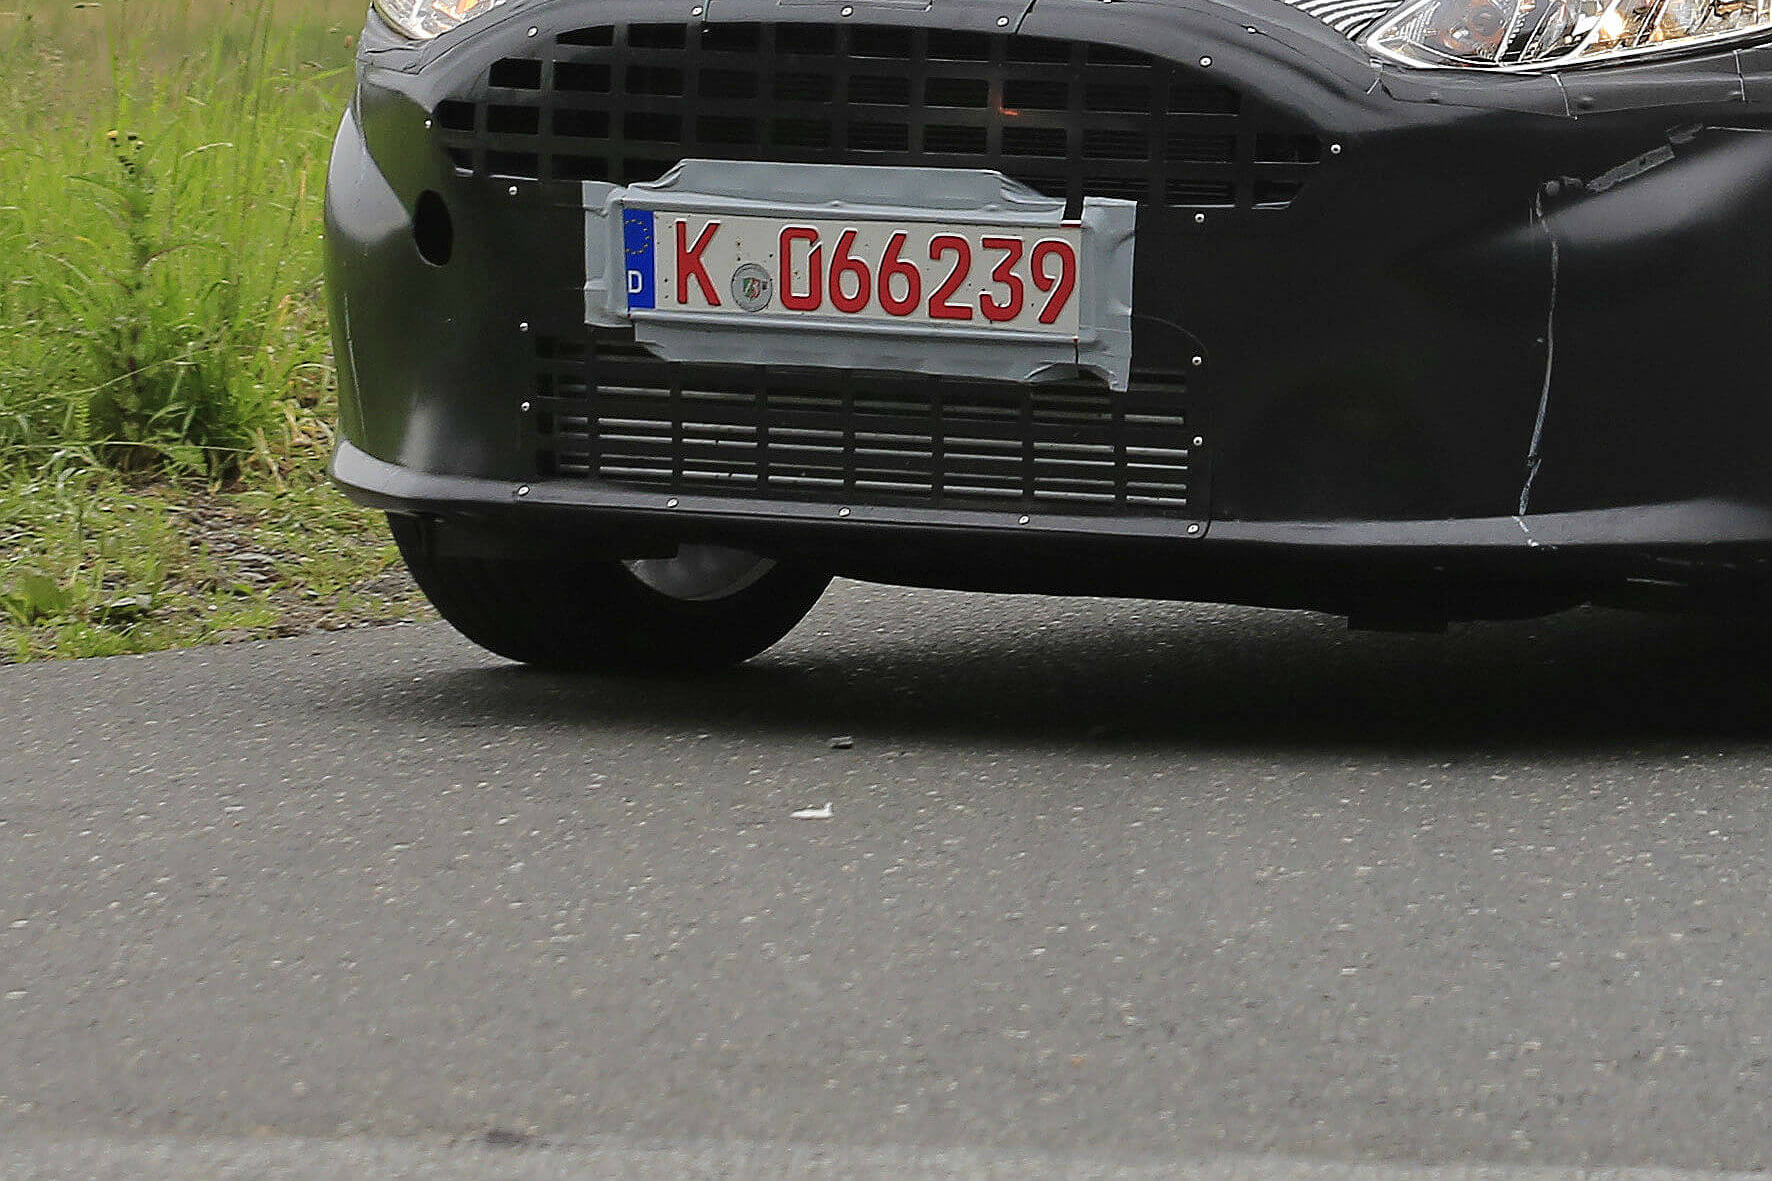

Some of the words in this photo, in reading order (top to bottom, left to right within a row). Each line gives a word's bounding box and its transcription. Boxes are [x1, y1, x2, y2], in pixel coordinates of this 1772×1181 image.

[627, 270, 643, 294] D
[675, 219, 721, 306] K
[779, 225, 1077, 324] 066239
